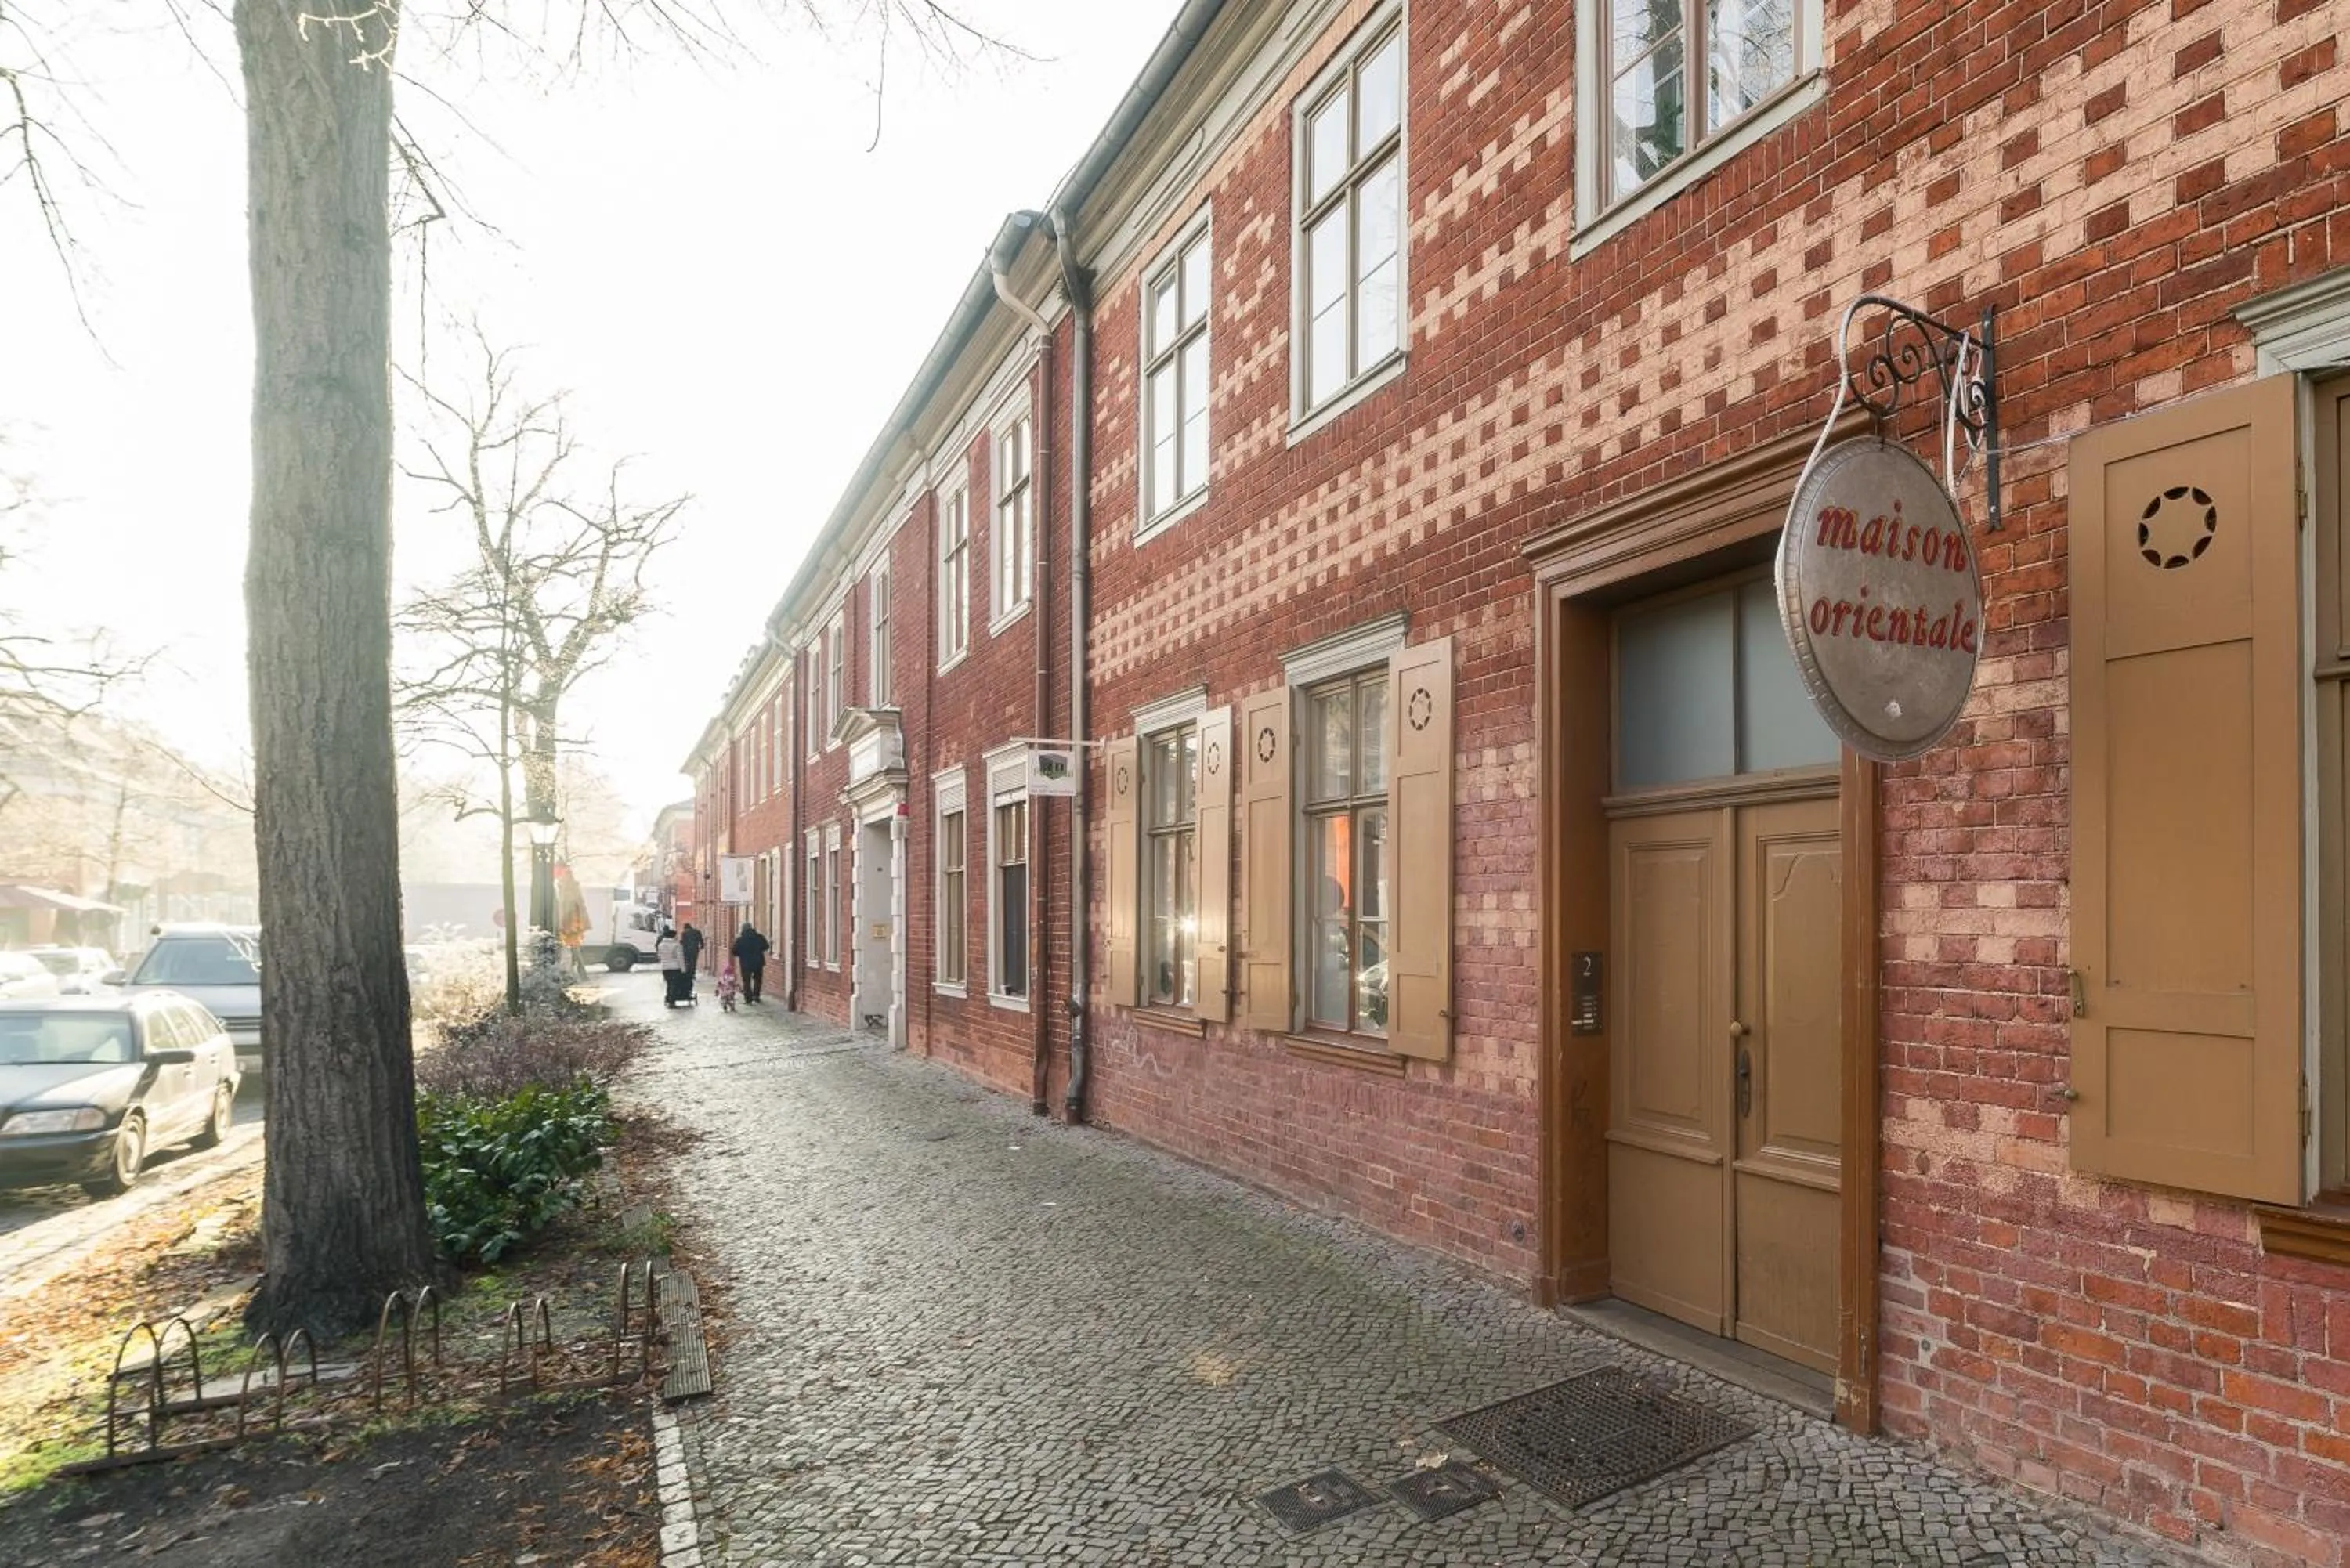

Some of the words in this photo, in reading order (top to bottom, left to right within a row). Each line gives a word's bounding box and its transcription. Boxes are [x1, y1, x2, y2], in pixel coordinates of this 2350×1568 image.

[1817, 499, 1966, 572] maison
[1810, 585, 1977, 653] orientale
[1583, 956, 1592, 976] 2
